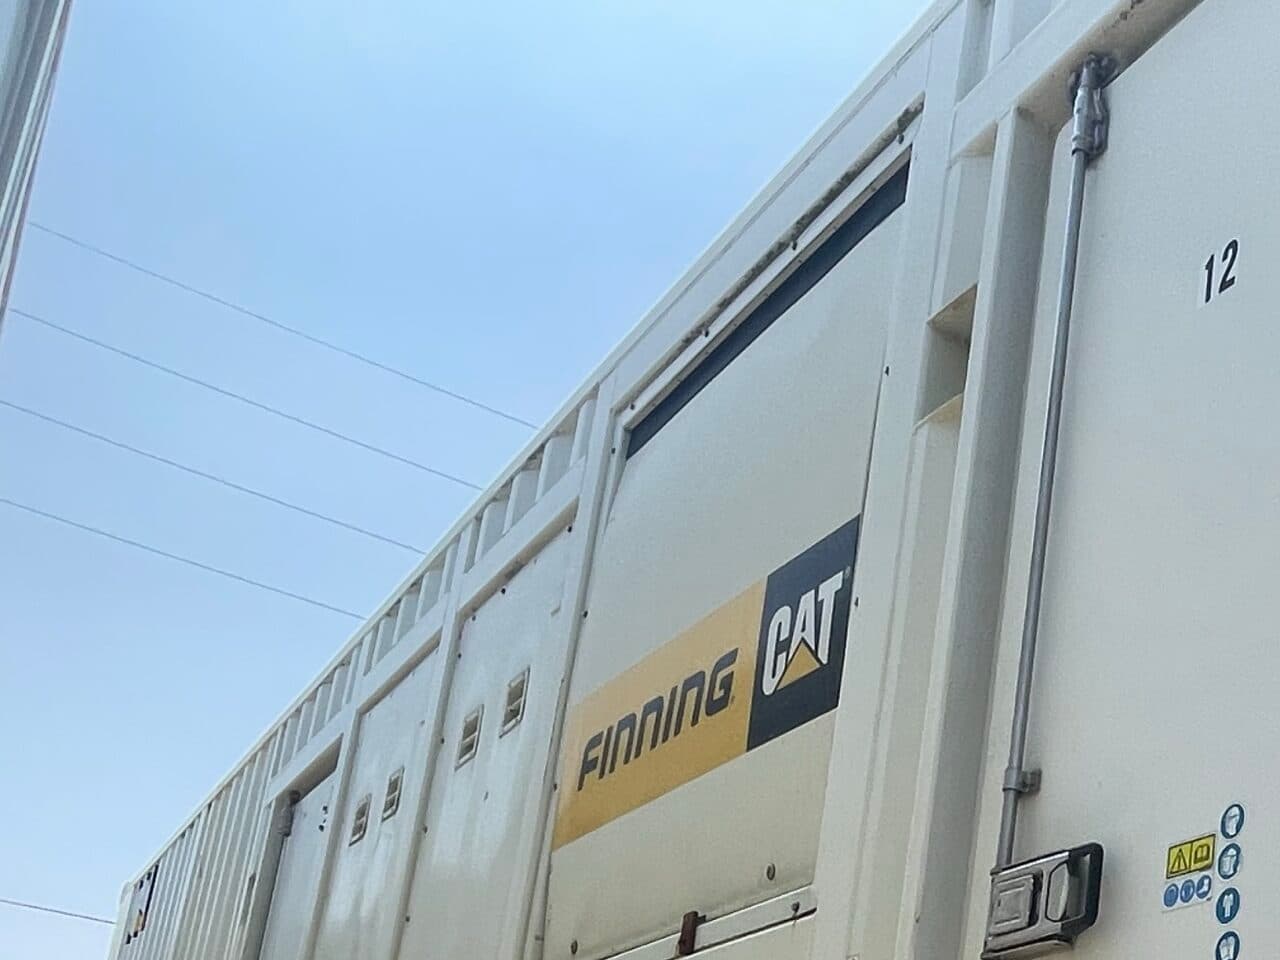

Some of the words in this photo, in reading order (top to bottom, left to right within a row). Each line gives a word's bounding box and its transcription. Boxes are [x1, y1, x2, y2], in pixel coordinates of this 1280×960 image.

[1205, 239, 1239, 304] 12
[577, 648, 739, 792] FINNING
[762, 571, 844, 696] CAT
